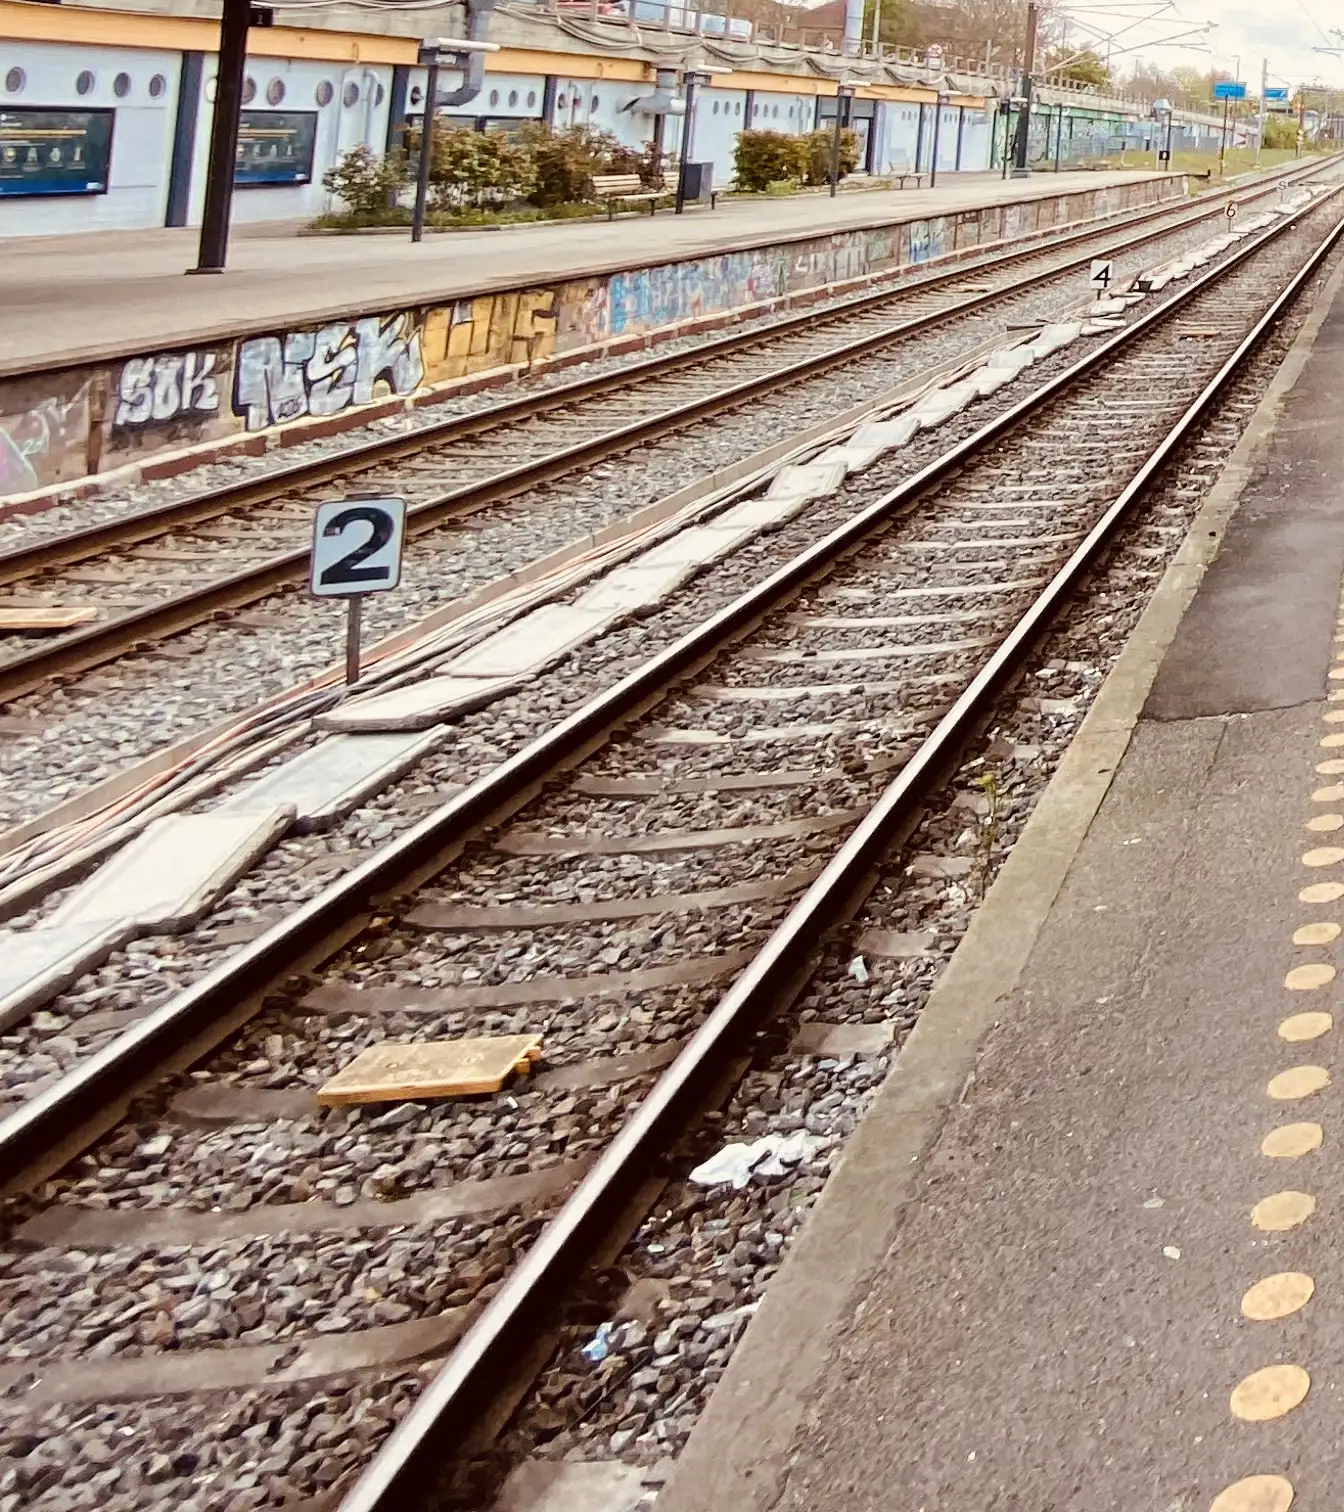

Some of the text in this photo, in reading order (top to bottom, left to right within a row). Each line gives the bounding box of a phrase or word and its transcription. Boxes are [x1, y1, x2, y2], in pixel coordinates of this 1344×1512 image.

[1226, 203, 1236, 218] 6
[1092, 263, 1111, 288] 4
[319, 509, 395, 586] 2
